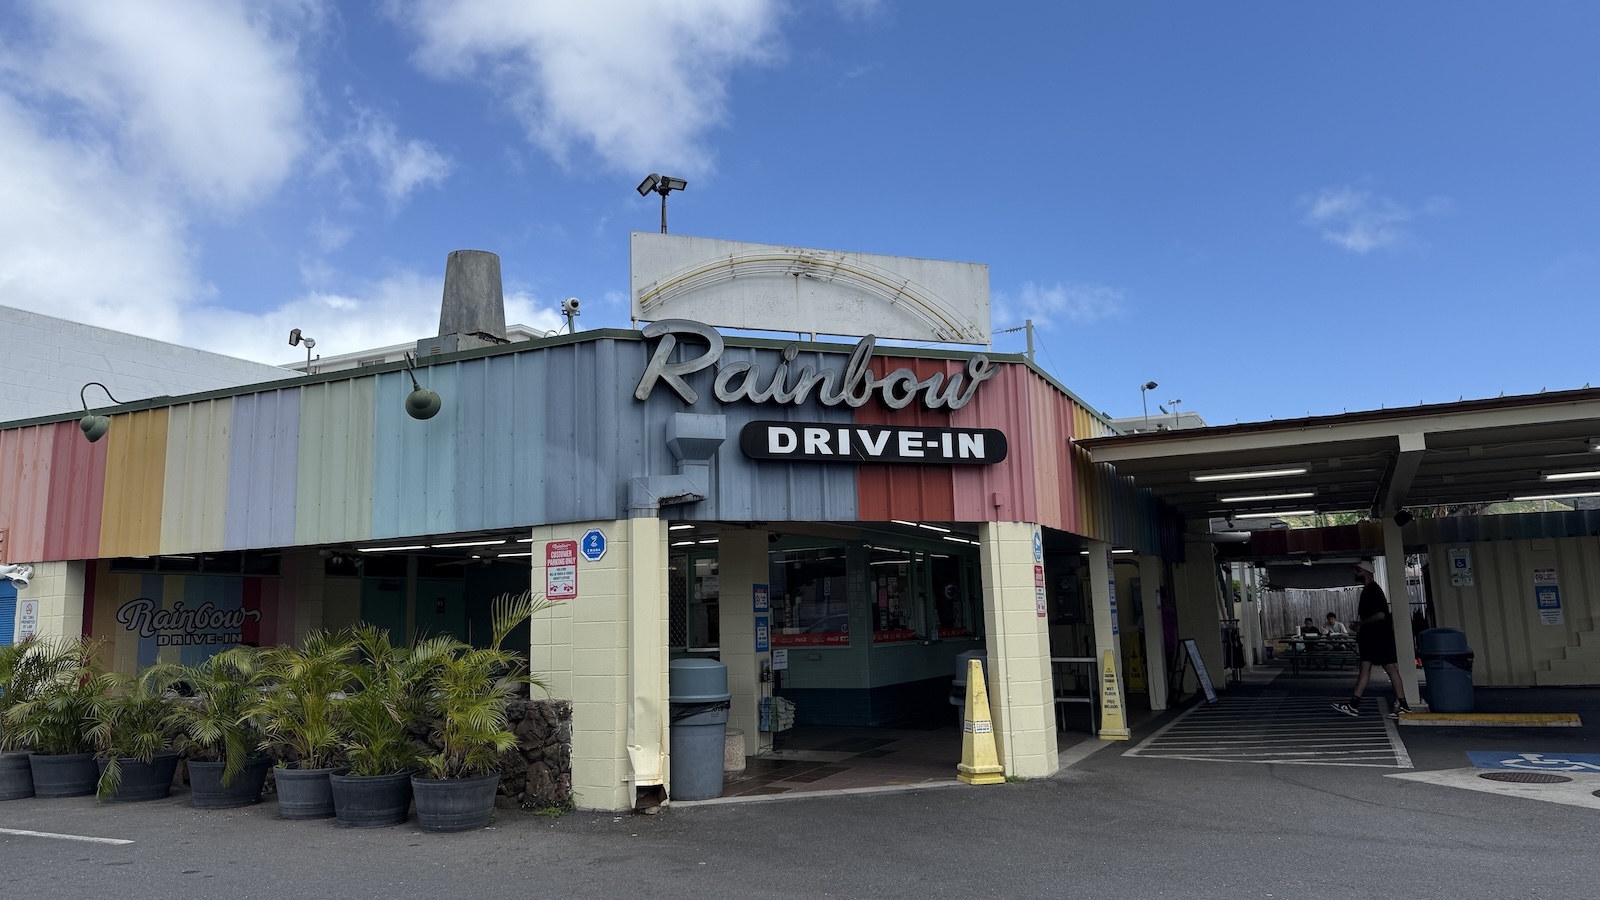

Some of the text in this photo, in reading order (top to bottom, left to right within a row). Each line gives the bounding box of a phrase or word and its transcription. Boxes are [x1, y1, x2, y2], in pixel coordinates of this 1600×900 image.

[634, 319, 1000, 410] Rainbow
[768, 426, 985, 459] DRIVE-IN
[547, 557, 576, 566] PARKING ONLY
[550, 550, 572, 558] CUSTOMER
[116, 598, 262, 638] Rainbow
[157, 633, 243, 646] DRIVE-IN
